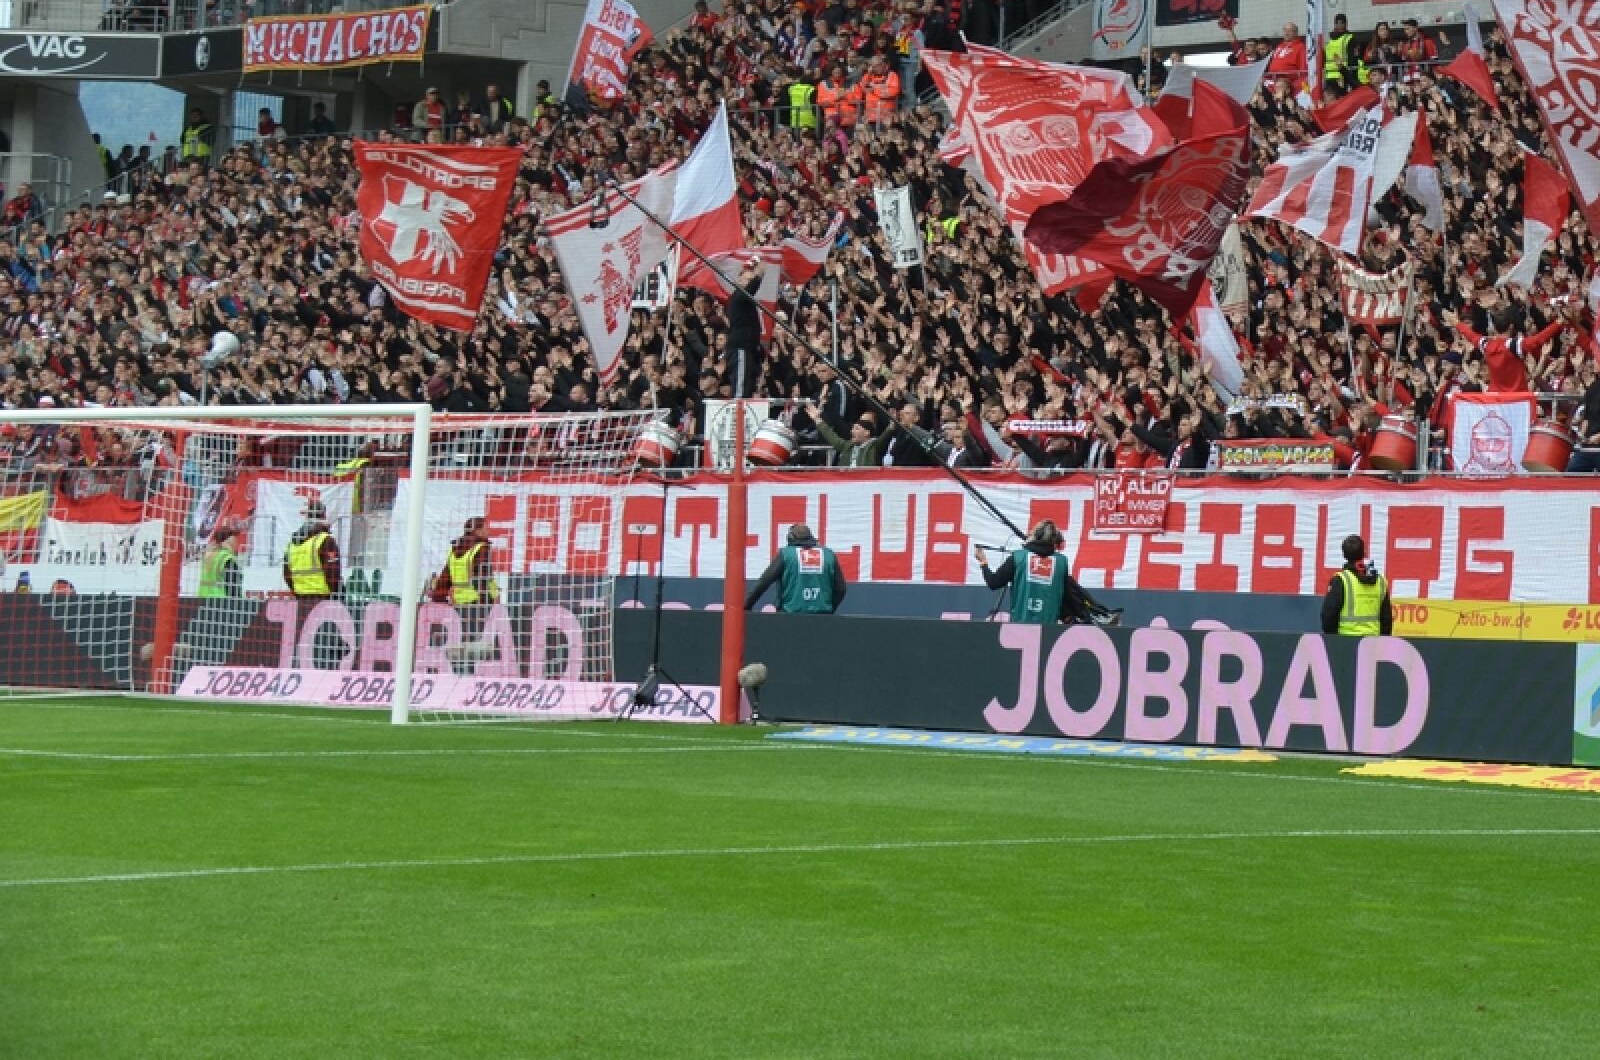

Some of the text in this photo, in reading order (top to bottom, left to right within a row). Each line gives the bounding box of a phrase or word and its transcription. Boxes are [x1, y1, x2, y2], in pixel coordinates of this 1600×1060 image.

[26, 35, 87, 59] VAG
[247, 11, 426, 66] MUCHACHOS
[1389, 603, 1429, 625] OTTO
[1456, 608, 1532, 630] lotto-bw.de
[194, 670, 302, 697] JOBRAD
[465, 681, 566, 710] JOBRAD
[982, 622, 1430, 755] JOBRAD
[590, 686, 716, 717] JORAD
